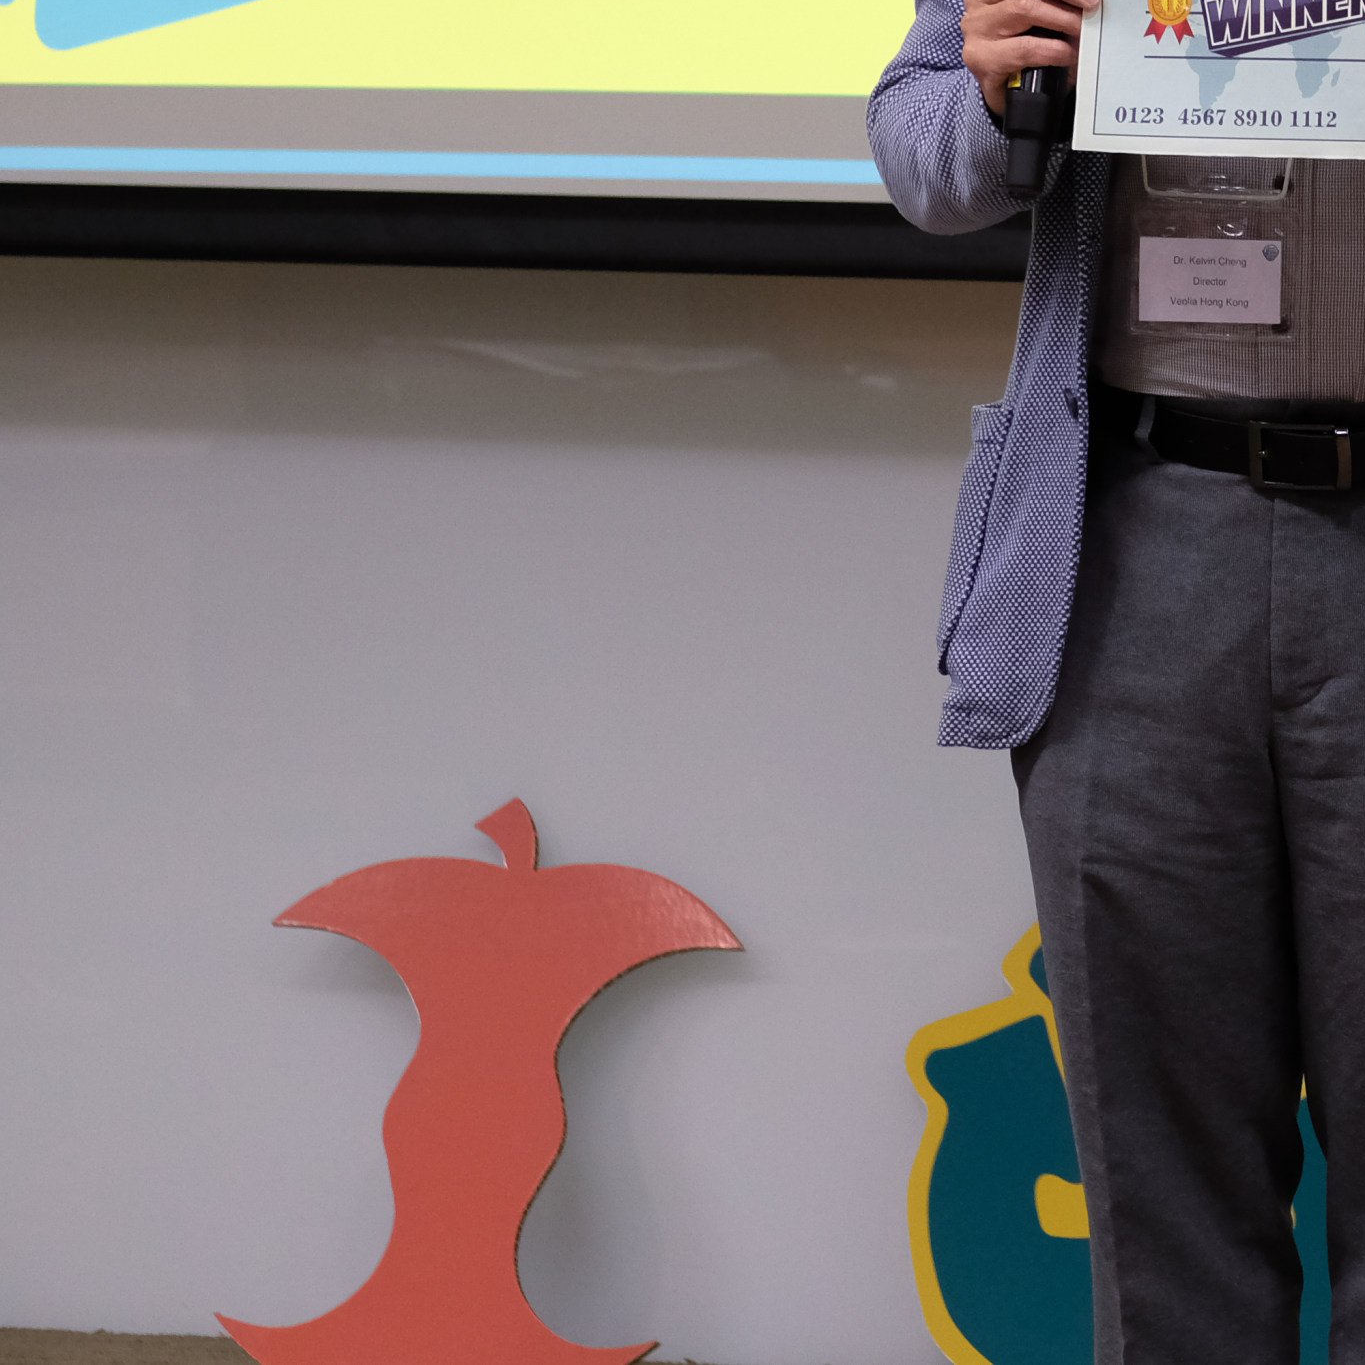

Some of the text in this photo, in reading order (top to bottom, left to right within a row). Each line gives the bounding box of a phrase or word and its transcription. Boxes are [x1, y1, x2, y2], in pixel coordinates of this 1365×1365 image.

[1114, 105, 1338, 129] 0123 4567 8910 1112
[1173, 255, 1187, 266] Dr.
[1188, 255, 1216, 267] Kelvin
[1193, 276, 1228, 287] Director
[1170, 296, 1249, 309] Veolia Hong Kong
